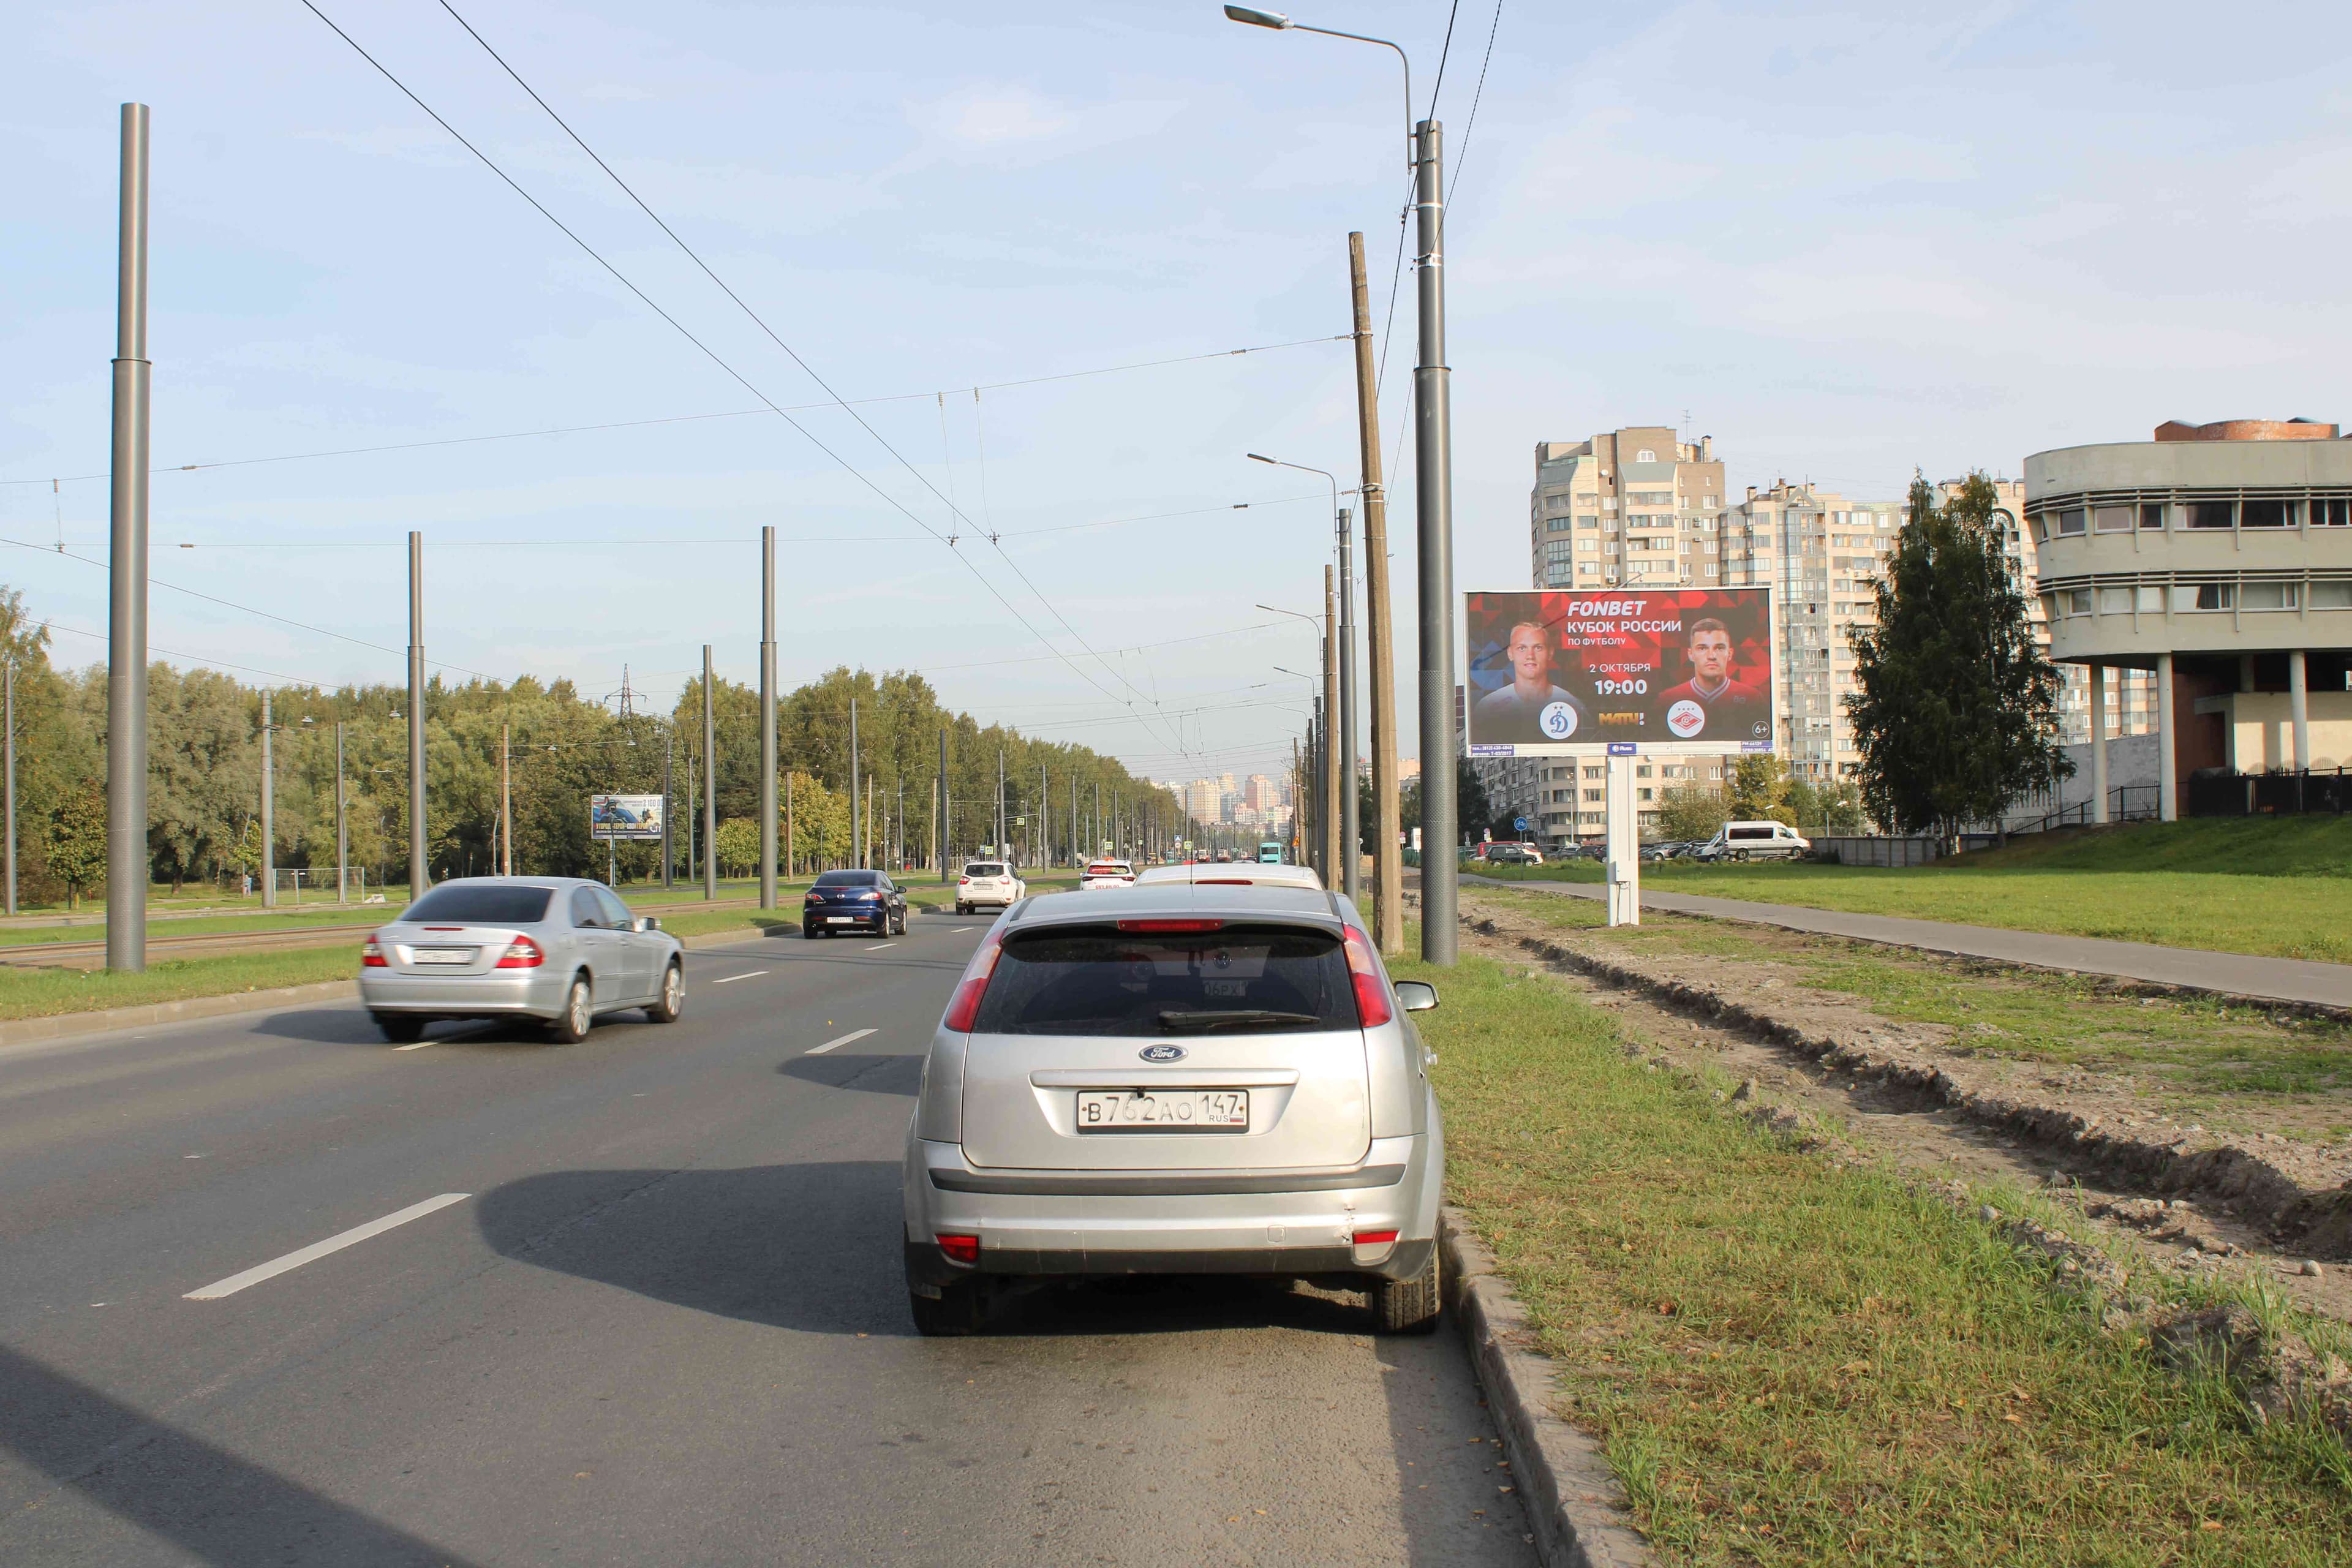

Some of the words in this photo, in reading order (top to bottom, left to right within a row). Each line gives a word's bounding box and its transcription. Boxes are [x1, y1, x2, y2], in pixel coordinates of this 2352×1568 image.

[1567, 600, 1647, 617] FONBET
[1567, 621, 1615, 633] КУБОК
[1621, 620, 1681, 632] РОССИИ
[1589, 664, 1596, 673] 2
[1599, 663, 1651, 673] ОКТЯБРЯ
[1594, 679, 1647, 695] 19:00
[1755, 725, 1767, 734] 6+
[1204, 982, 1236, 995] 06РХ
[1150, 1047, 1175, 1058] Ford
